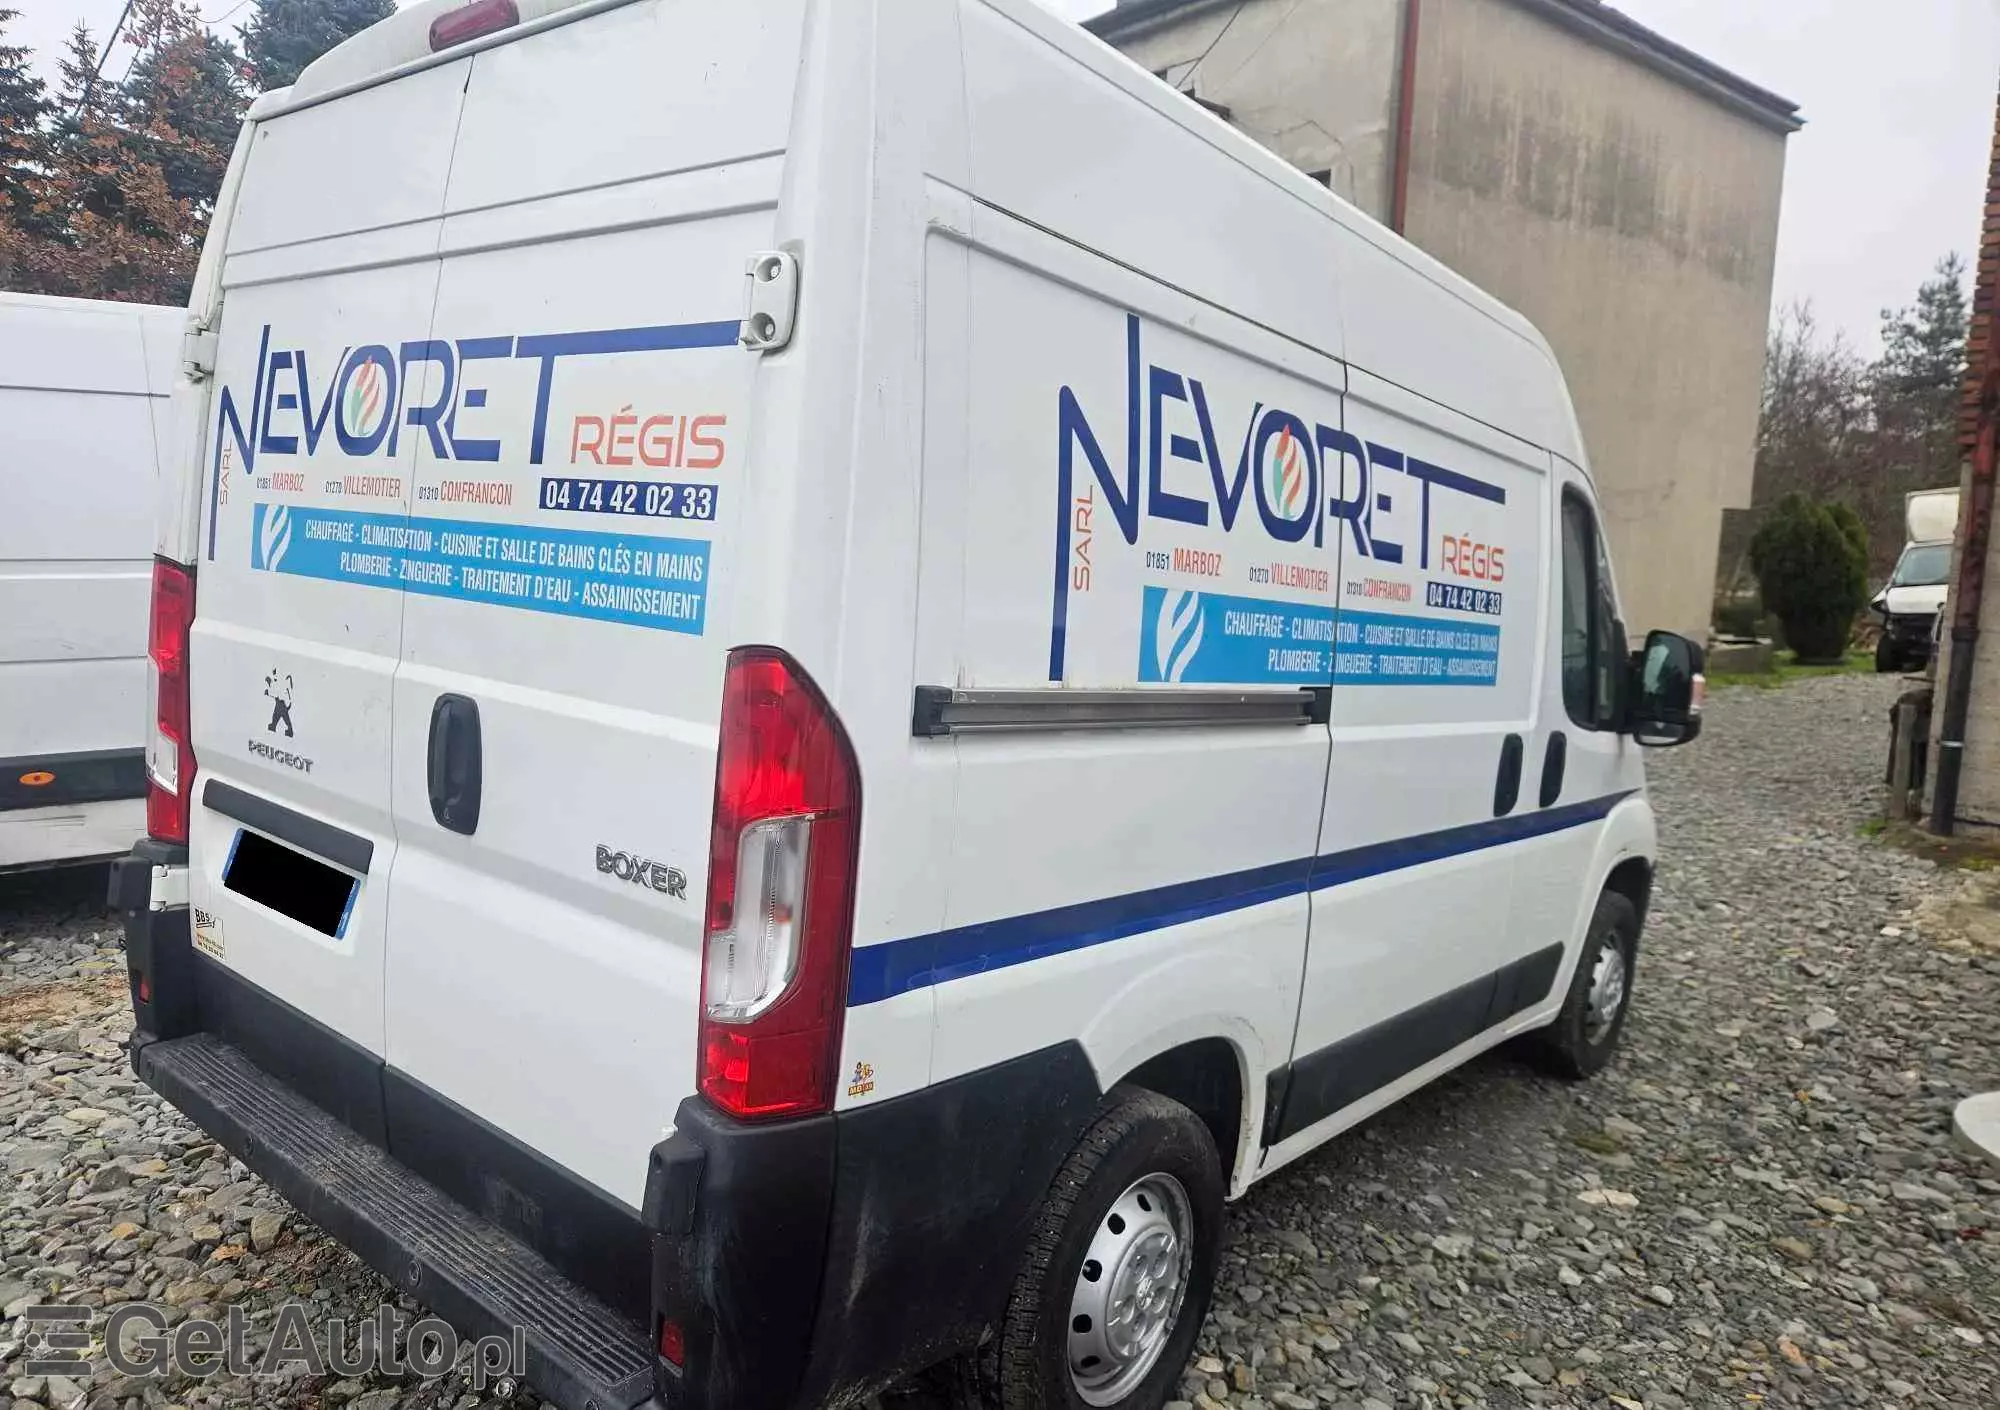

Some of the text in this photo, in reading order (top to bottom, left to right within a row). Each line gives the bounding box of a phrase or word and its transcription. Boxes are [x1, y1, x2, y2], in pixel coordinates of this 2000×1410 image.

[208, 320, 742, 560] NEVORET
[571, 404, 727, 468] RÉGIS
[220, 439, 232, 504] SARL
[272, 472, 304, 492] MARBOZ
[325, 475, 401, 498] 01270 VILLEMOTIER
[418, 480, 512, 506] 01310 CONFRANCON
[546, 480, 712, 518] 04 74 42 02 33
[1049, 313, 1505, 681] NEVORET
[305, 519, 354, 543] CHAUFFAGE
[361, 524, 432, 552] CLIMATISATION
[440, 535, 483, 558] CUISINE
[485, 538, 500, 560] ET
[501, 540, 536, 564] SALLE
[539, 543, 555, 566] DE
[559, 544, 595, 570] BAINS
[599, 543, 630, 575] CLÉS
[634, 551, 652, 576] EN
[656, 554, 703, 582] MAINS
[1073, 484, 1095, 592] SARL
[1146, 548, 1222, 577] 01851 MARBOZ
[1441, 533, 1505, 582] RÉGIS
[340, 551, 392, 577] PLOMBERIE
[461, 566, 531, 598] TRAITEMENT
[534, 577, 571, 602] D'EAU
[582, 582, 701, 621] ASSAINISSEMENT
[1249, 562, 1328, 592] 01270 VILLEMOTIER
[1429, 583, 1500, 614] 04 74 42 02 33
[1224, 611, 1284, 638] CHAUFFAGE
[1292, 617, 1358, 643] CLIMATISATION
[1365, 624, 1395, 646] CUISINE
[1268, 649, 1320, 673] PLOMBERIE
[1379, 654, 1422, 675] TRAITEMENT
[248, 739, 313, 774] PEUGEOT
[596, 843, 687, 901] BOXER
